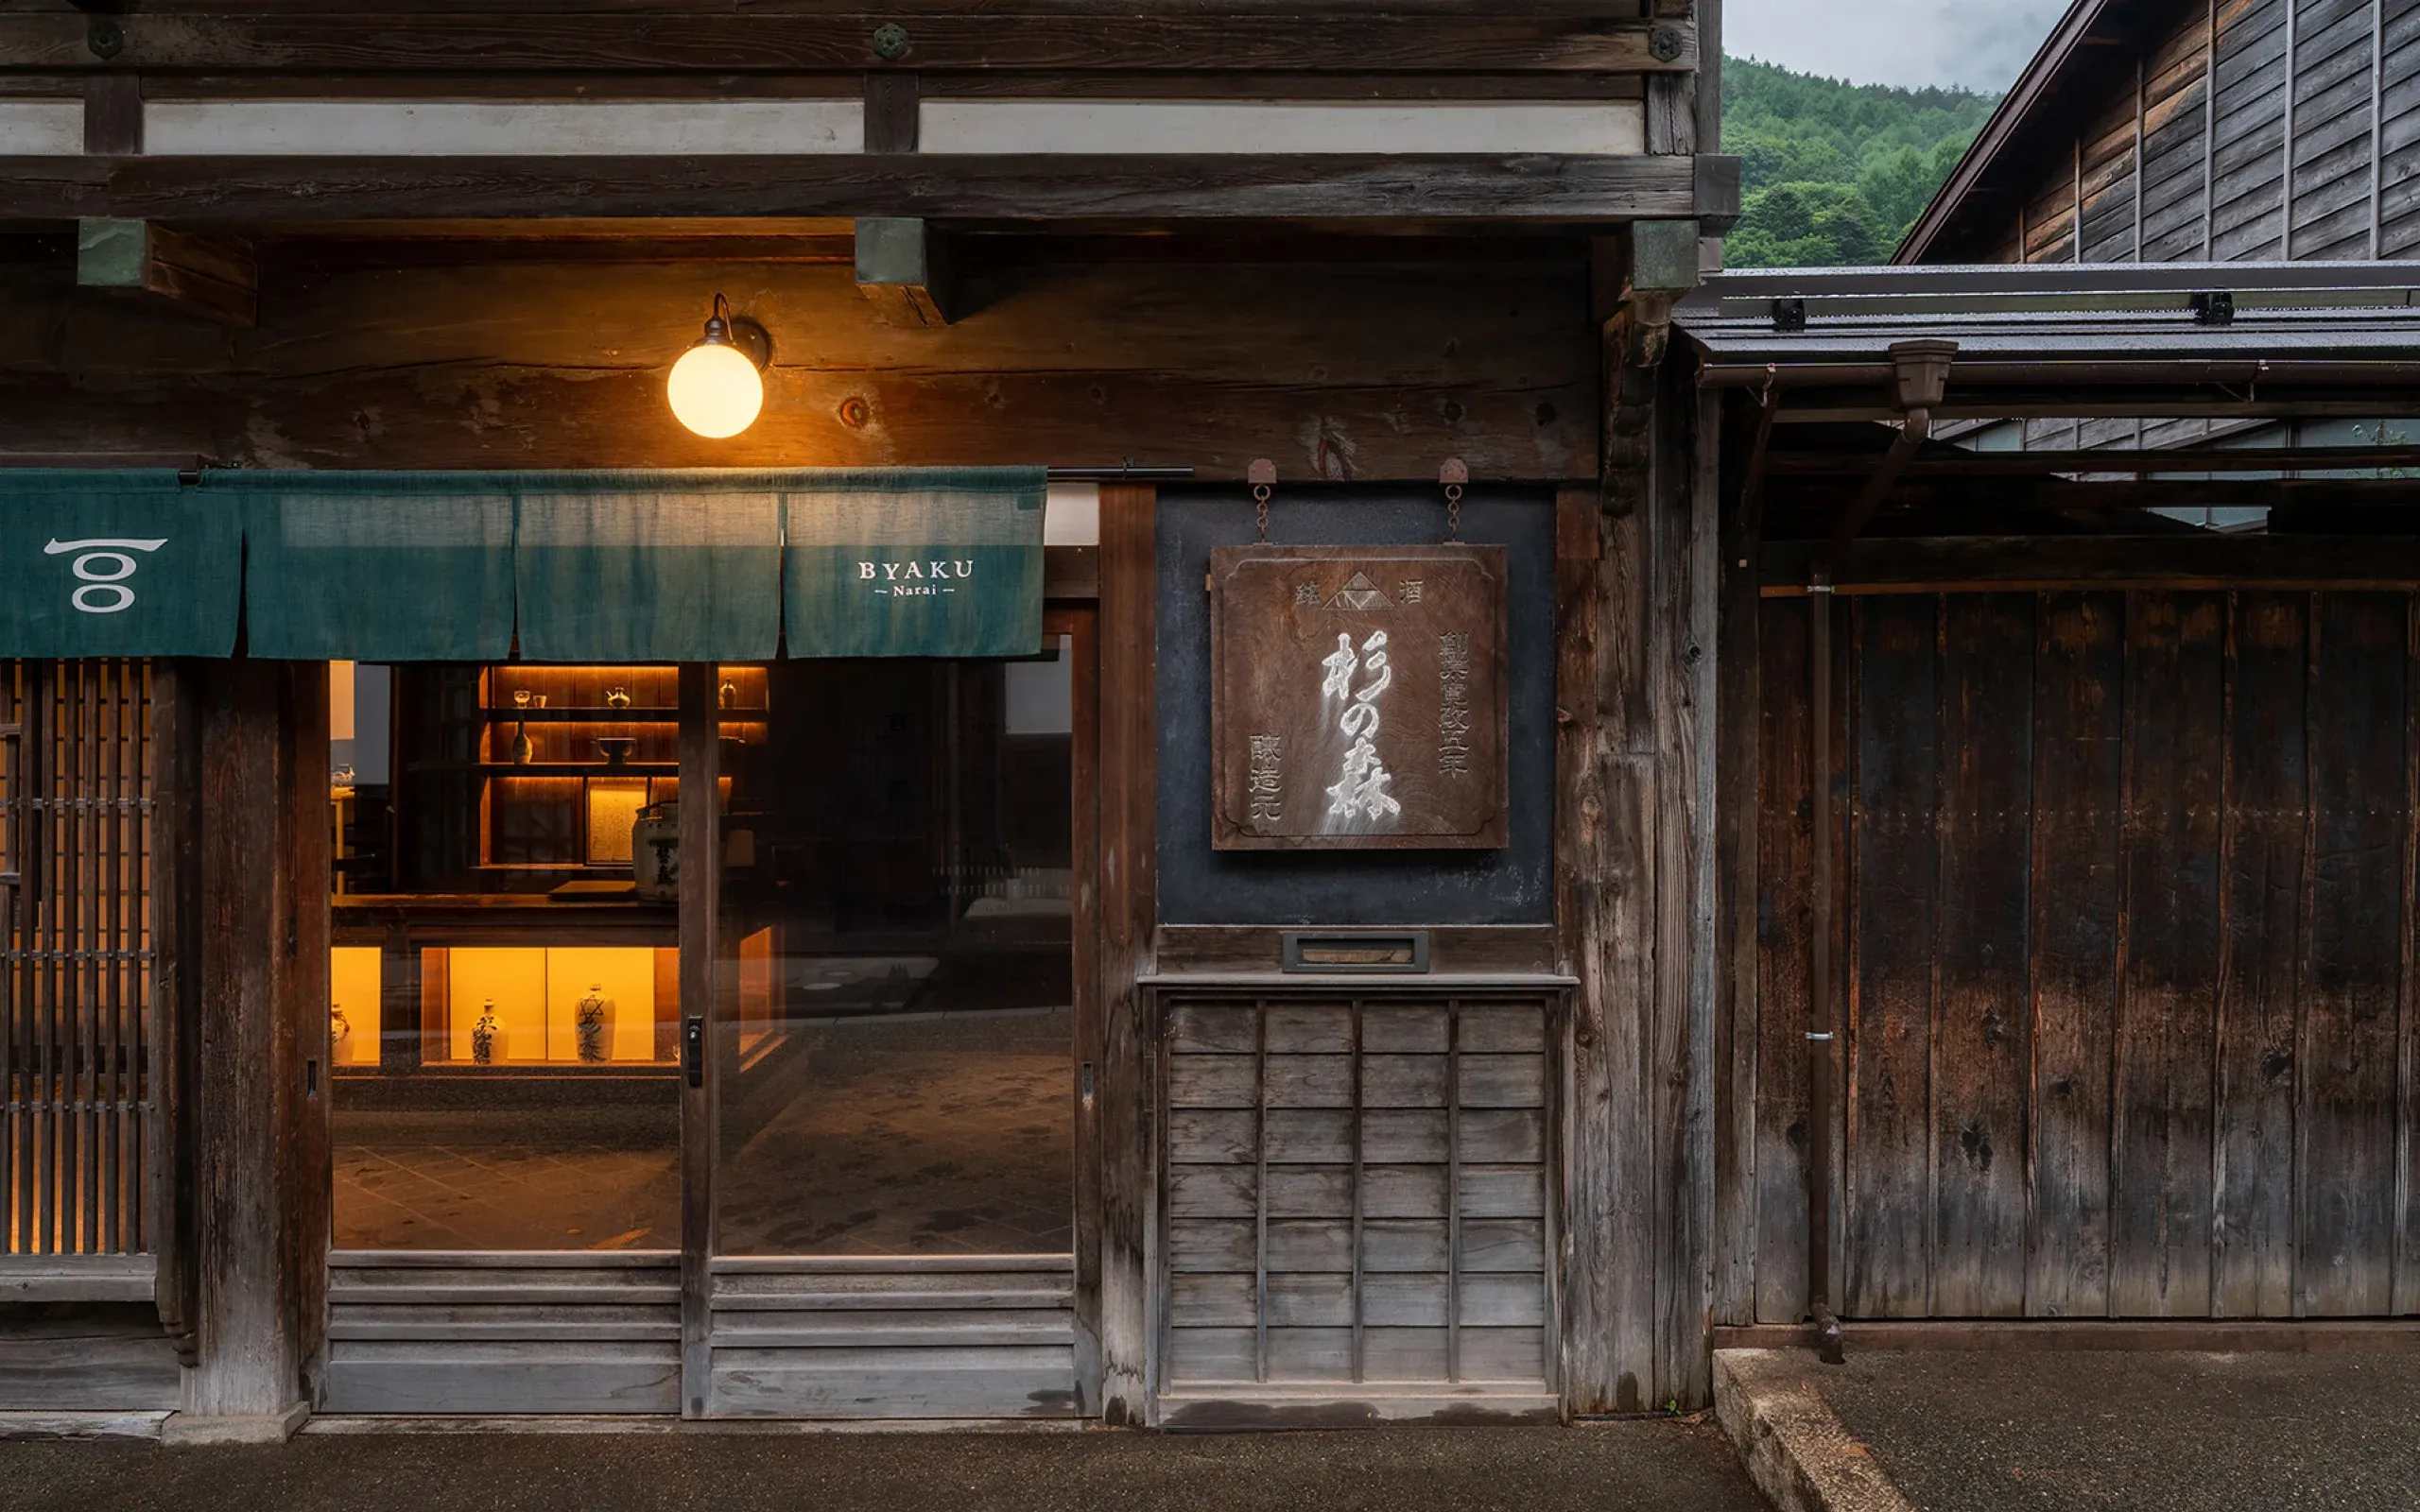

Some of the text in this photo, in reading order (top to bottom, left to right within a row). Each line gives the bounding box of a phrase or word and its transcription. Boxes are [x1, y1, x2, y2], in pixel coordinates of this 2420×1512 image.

[857, 559, 975, 580] BYAKU
[892, 584, 937, 597] Narai
[1322, 630, 1402, 821] 杉の森
